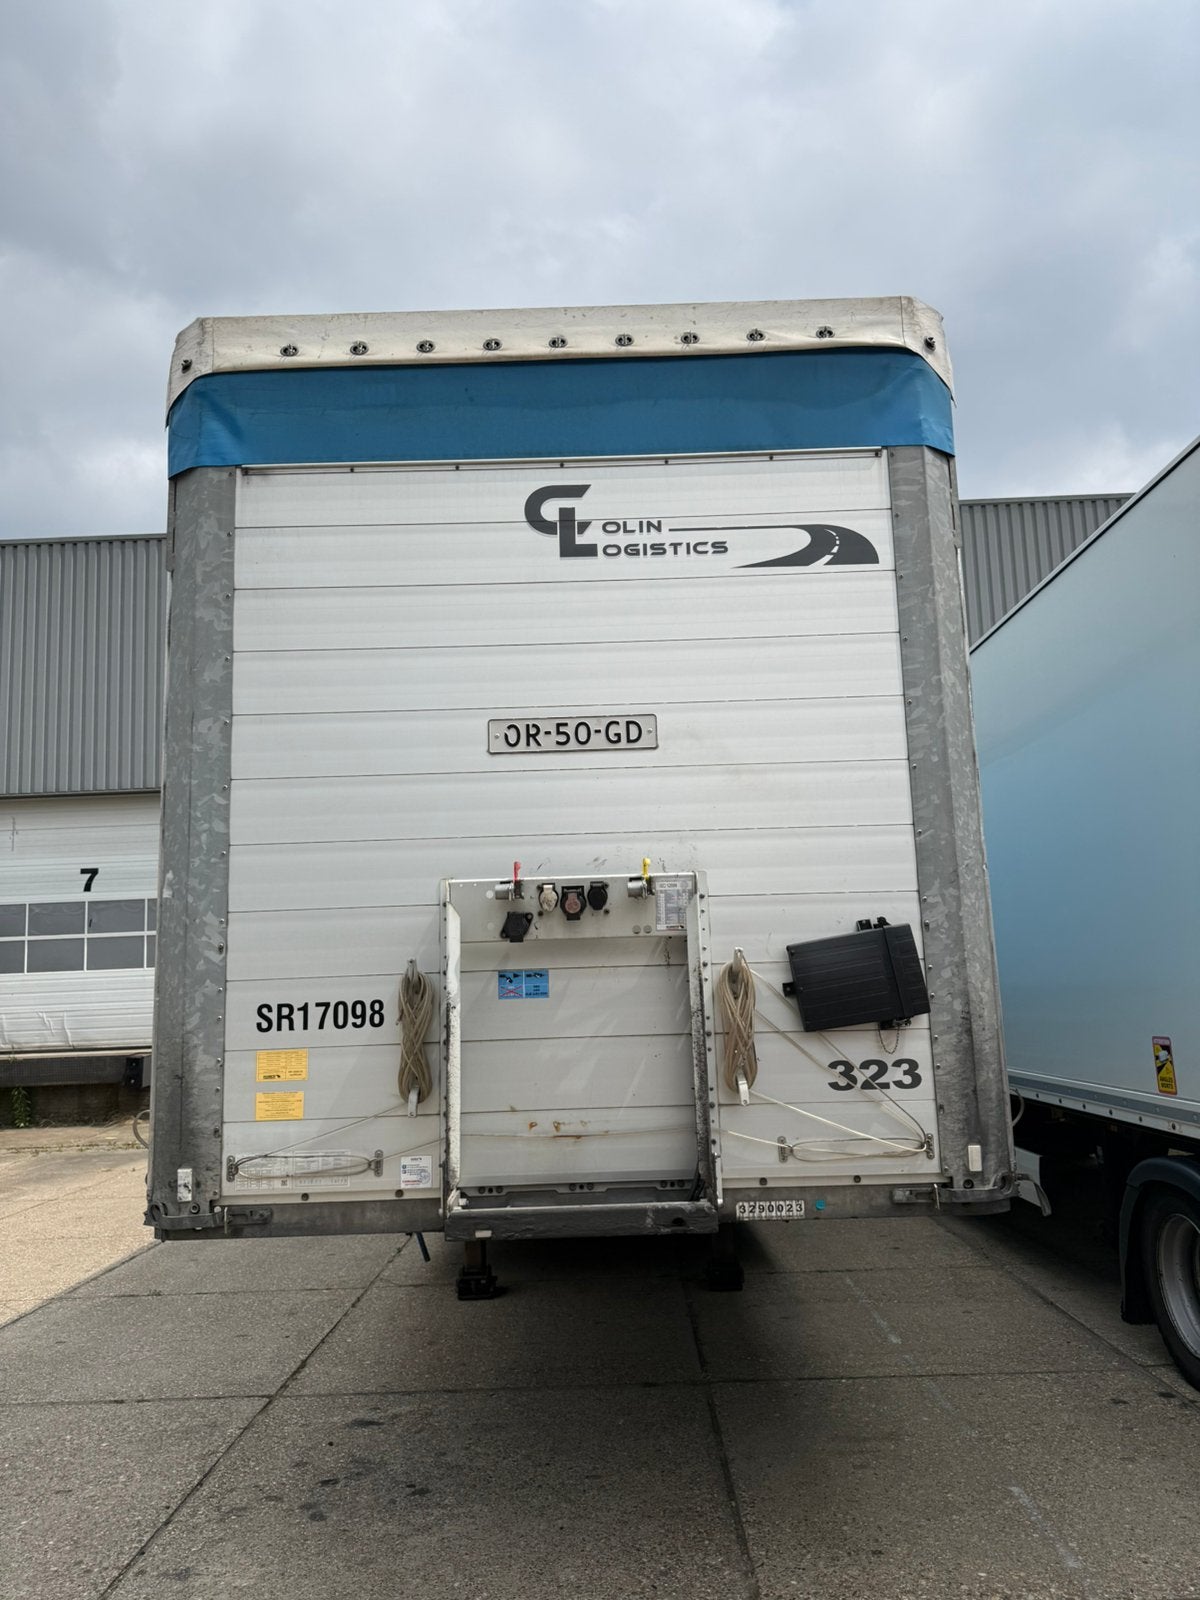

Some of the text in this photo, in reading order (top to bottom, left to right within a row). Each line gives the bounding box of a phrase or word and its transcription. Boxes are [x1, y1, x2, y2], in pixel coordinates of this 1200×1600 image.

[504, 720, 643, 748] OR-50-GD
[80, 868, 99, 892] 7
[256, 999, 385, 1033] SR17098
[827, 1058, 922, 1091] 323
[739, 1203, 803, 1214] 3290023
